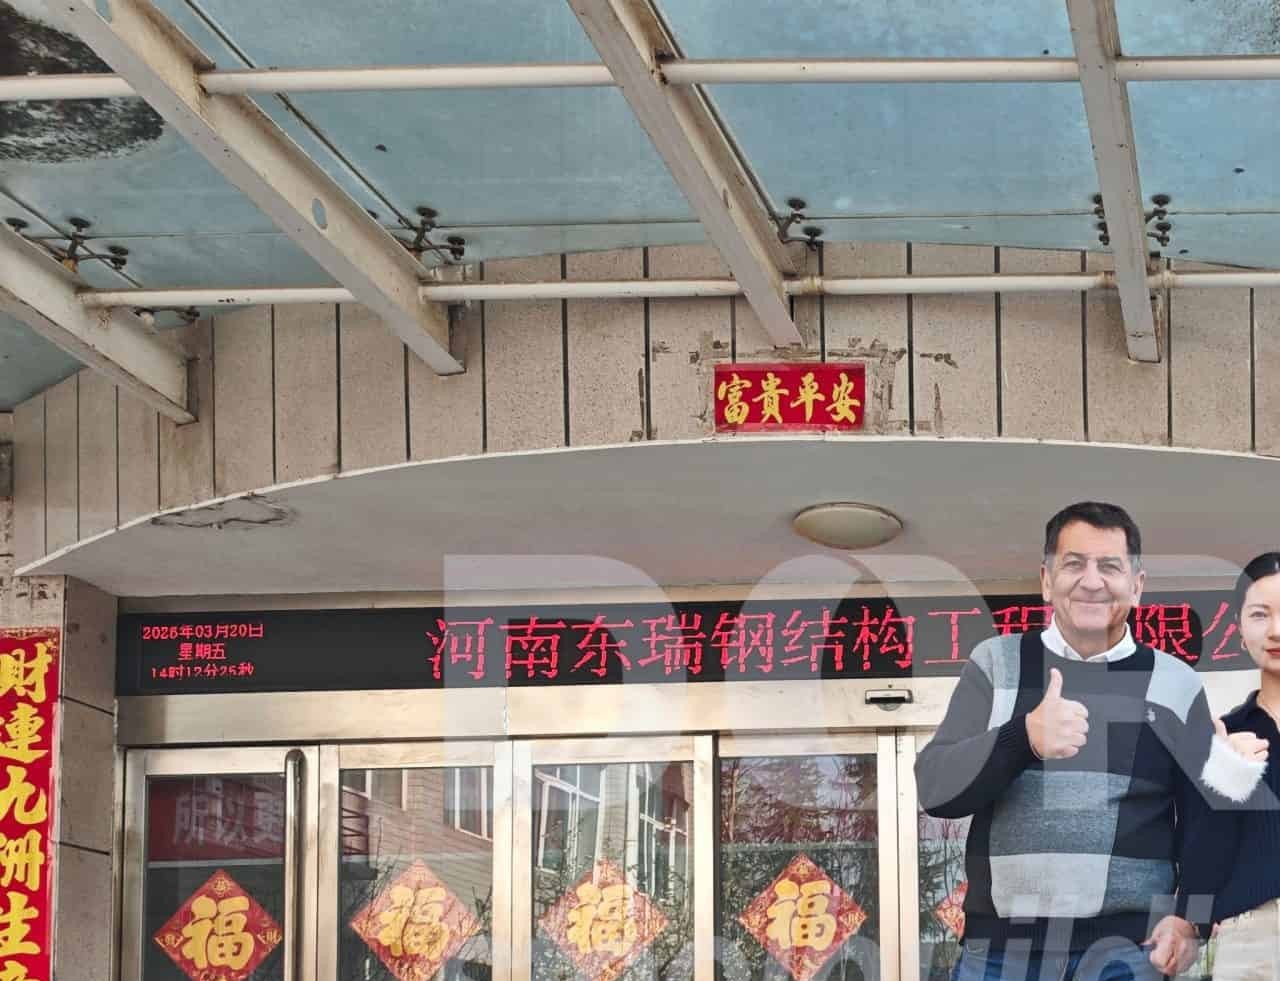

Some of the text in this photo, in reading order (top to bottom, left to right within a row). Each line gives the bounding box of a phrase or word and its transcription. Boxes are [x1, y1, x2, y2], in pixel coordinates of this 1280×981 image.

[718, 372, 861, 425] 富貴平安
[178, 643, 227, 660] 星期五
[182, 895, 254, 970] 福
[378, 885, 449, 960] 福
[566, 881, 637, 957] 福
[766, 878, 837, 951] 福
